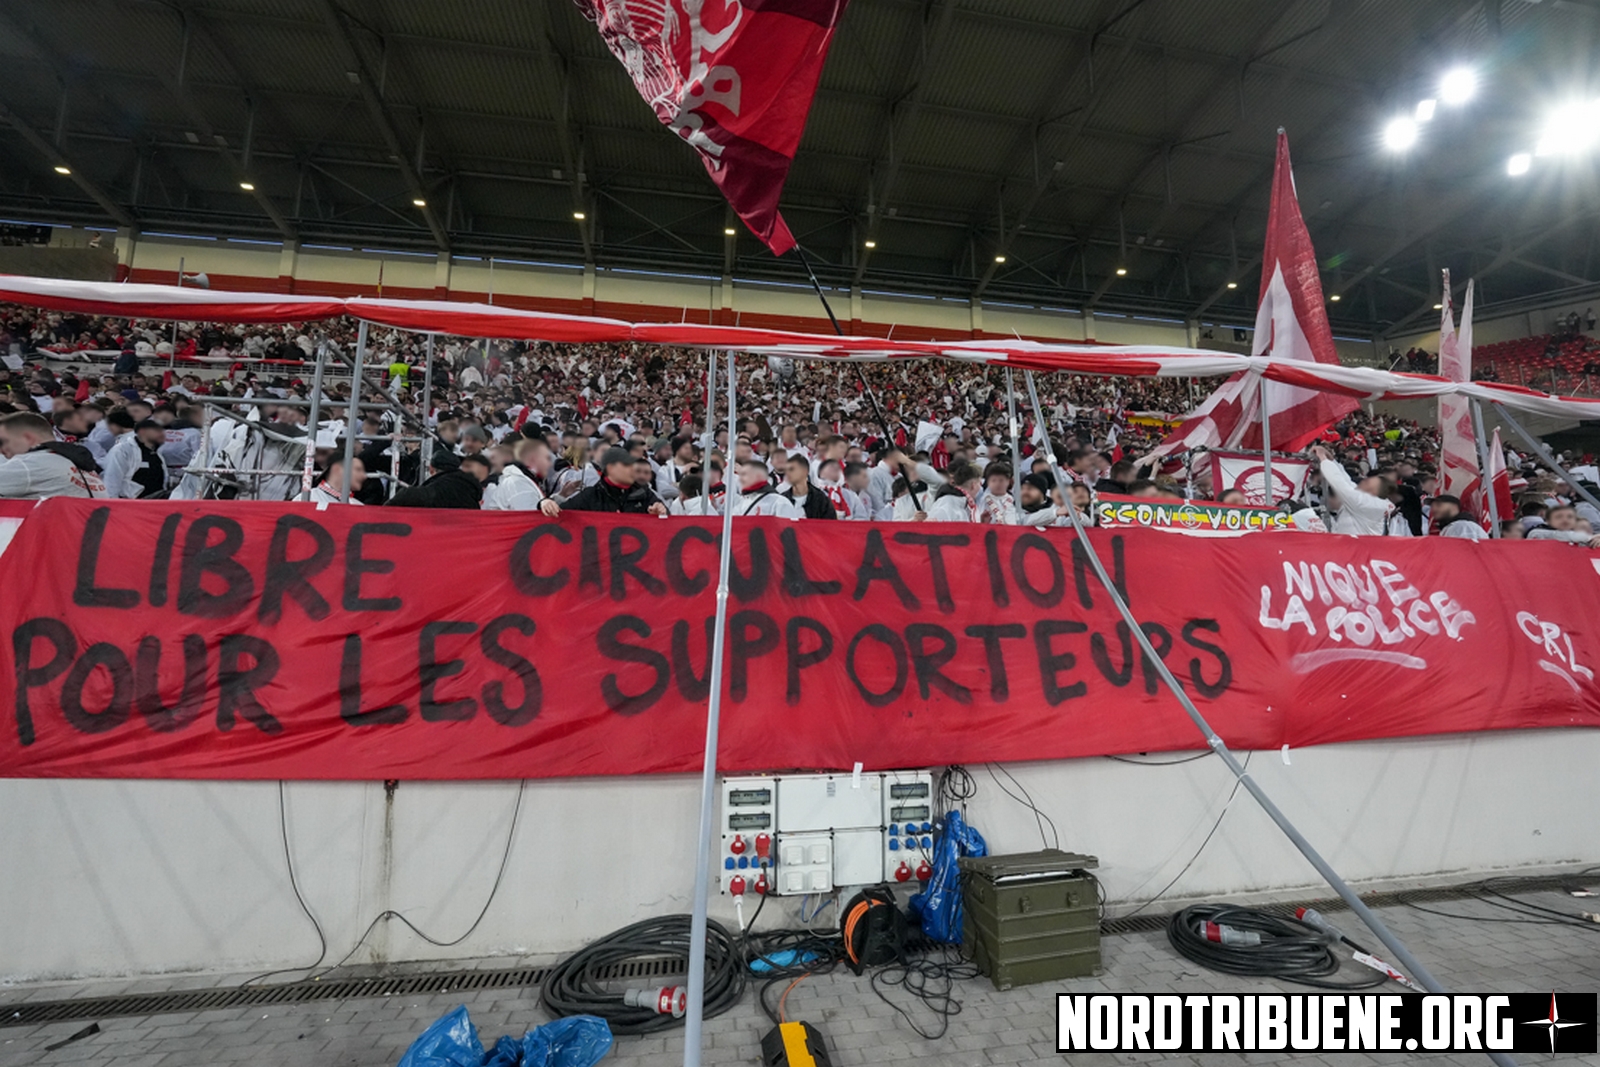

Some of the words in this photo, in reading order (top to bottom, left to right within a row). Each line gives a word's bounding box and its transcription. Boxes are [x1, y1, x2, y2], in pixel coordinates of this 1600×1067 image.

[72, 506, 412, 626] LIBRE
[508, 522, 1130, 615] CIRCULATION
[1283, 559, 1420, 609] NIQUE
[1259, 585, 1317, 636] LA
[1326, 591, 1476, 647] POLICE
[12, 616, 285, 746] POUR
[339, 613, 545, 728] LES
[596, 609, 1233, 717] SUPPORTEURS
